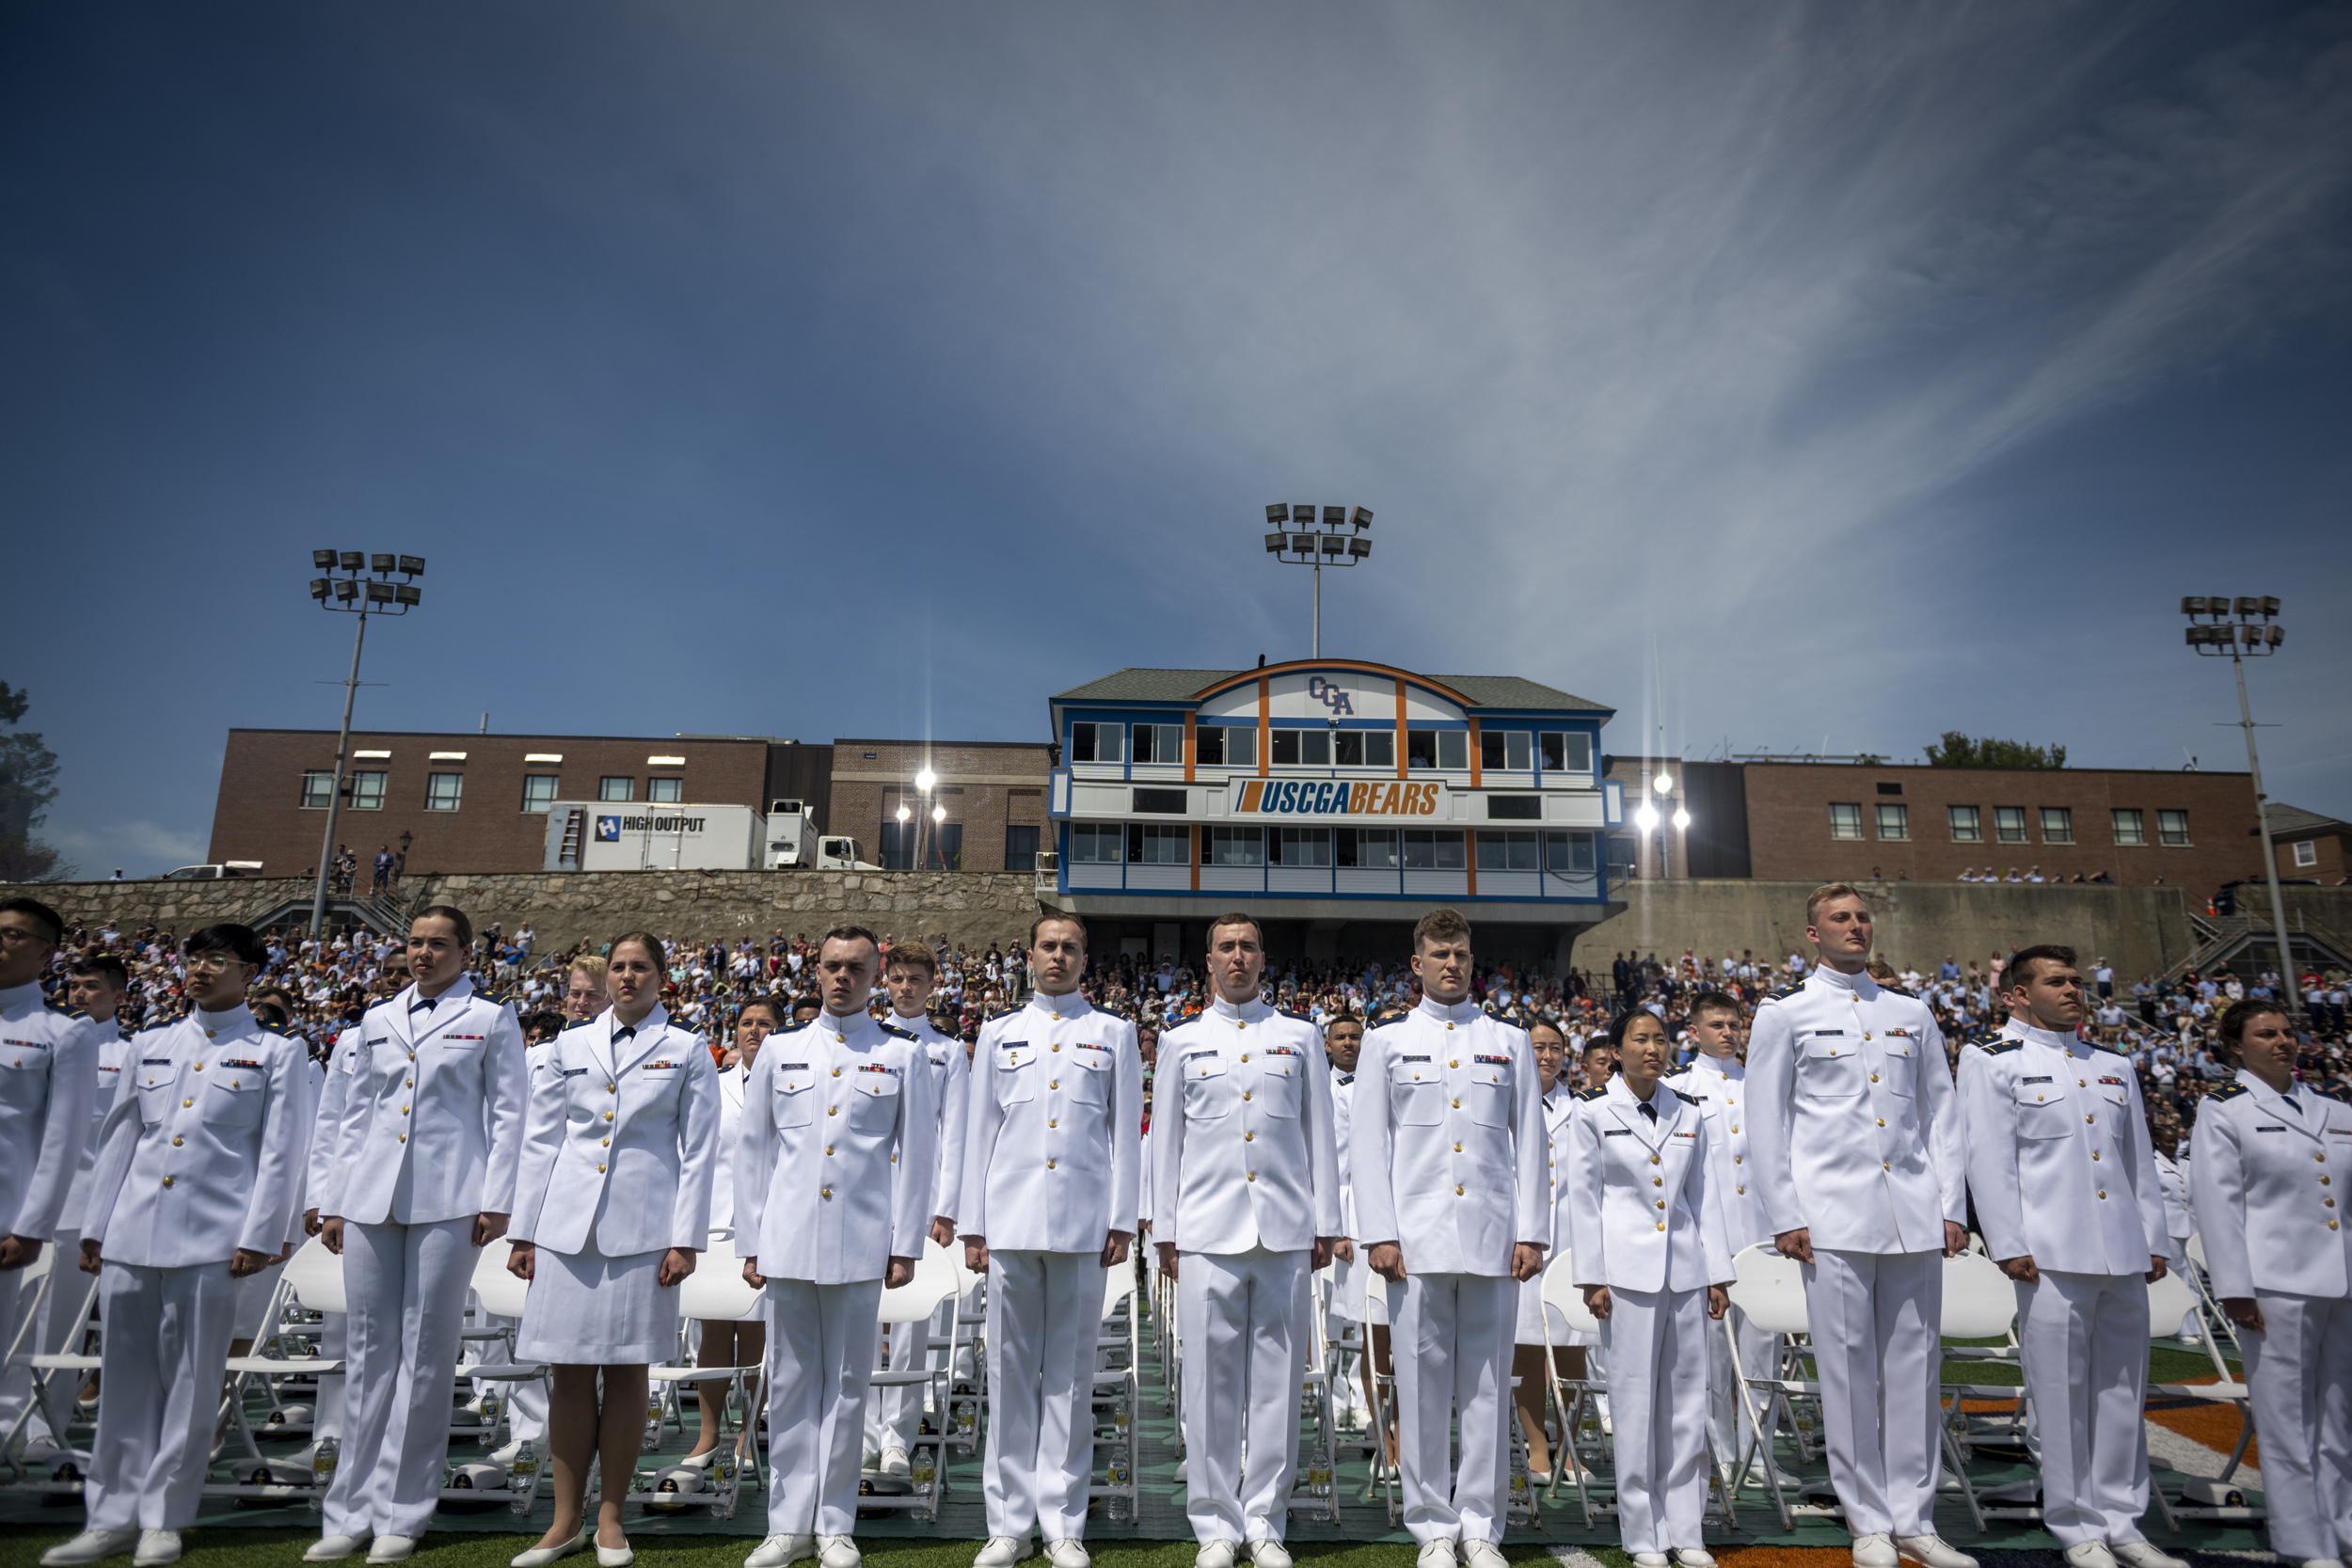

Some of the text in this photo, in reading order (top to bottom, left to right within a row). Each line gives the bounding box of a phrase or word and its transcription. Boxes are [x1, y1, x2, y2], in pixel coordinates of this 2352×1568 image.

[1309, 676, 1355, 715] CGA
[598, 819, 617, 836] H
[623, 816, 706, 832] HIGH OUTPUT
